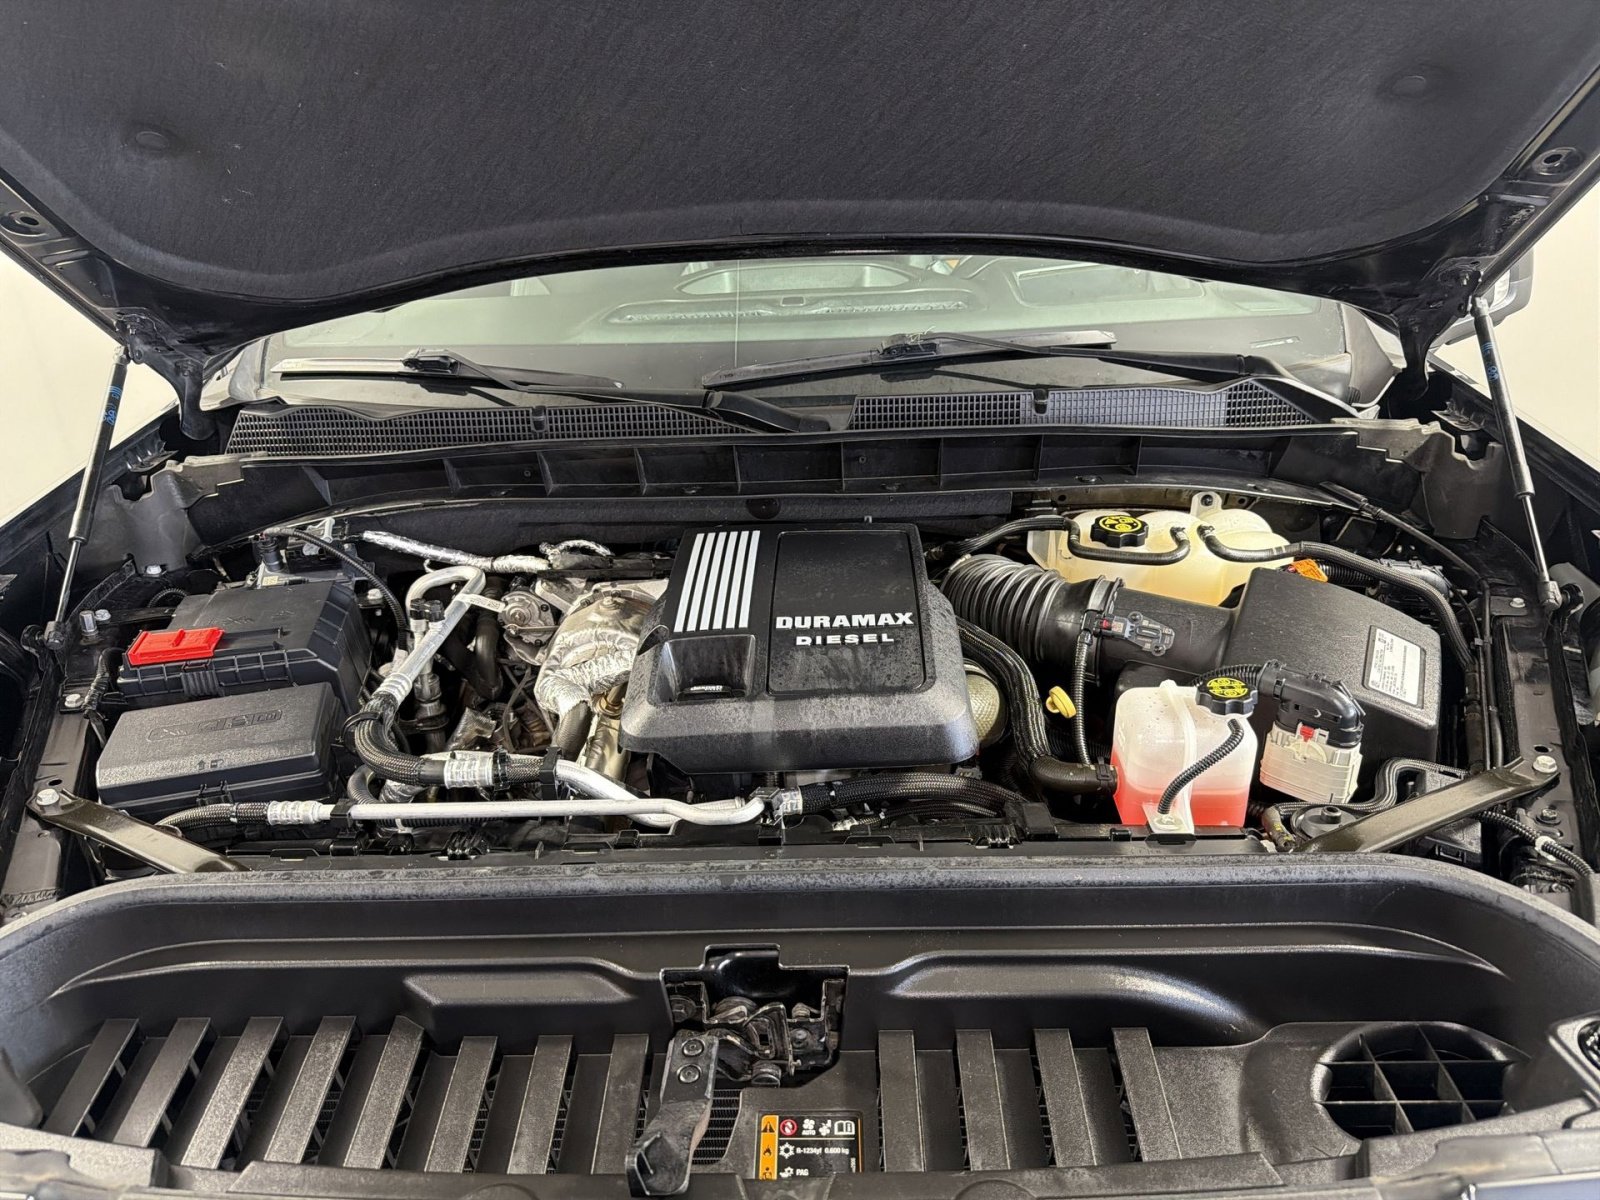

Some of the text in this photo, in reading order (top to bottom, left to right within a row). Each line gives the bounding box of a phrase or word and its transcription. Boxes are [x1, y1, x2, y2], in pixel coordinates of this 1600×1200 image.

[776, 612, 914, 630] DURAMAX
[796, 633, 894, 646] DIESEL
[842, 1147, 850, 1155] kg
[796, 1168, 809, 1176] PAG
